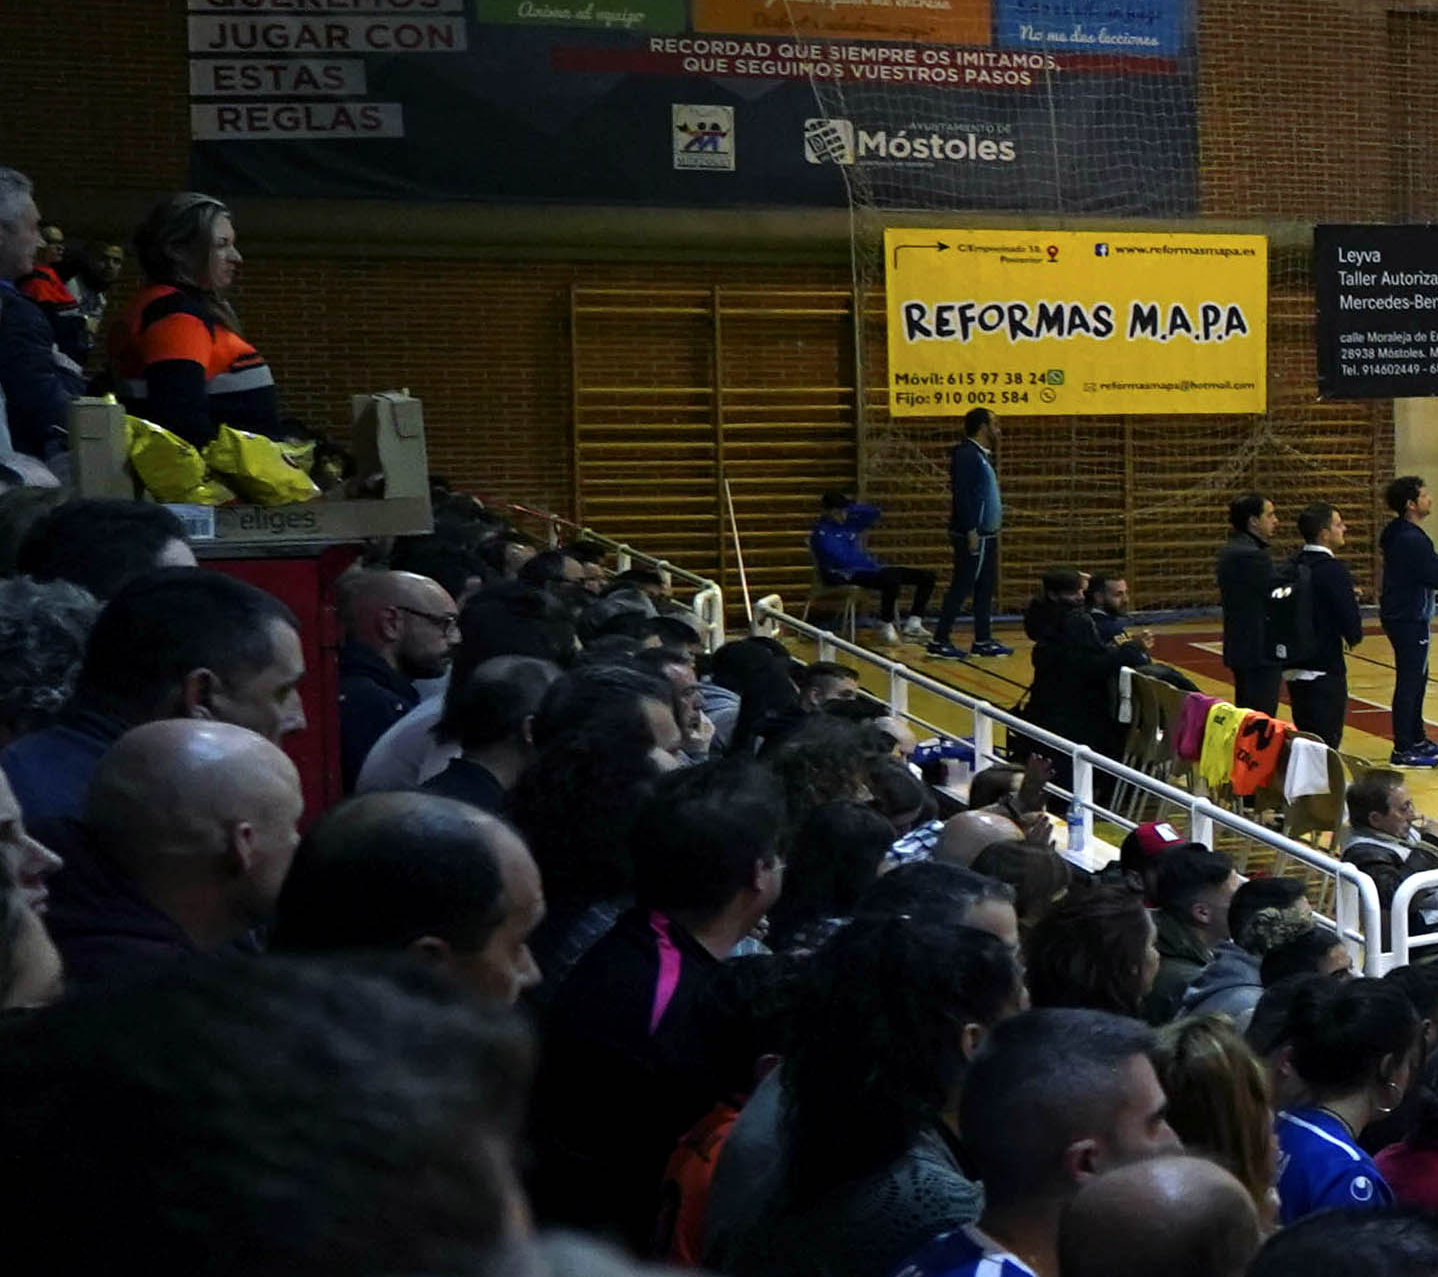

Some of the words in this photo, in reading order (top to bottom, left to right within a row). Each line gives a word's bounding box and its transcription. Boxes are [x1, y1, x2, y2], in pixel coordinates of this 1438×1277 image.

[208, 24, 350, 50] JUGAR
[364, 24, 454, 49] CON
[650, 37, 771, 58] RECORDAD
[778, 42, 822, 60] QUE
[829, 44, 916, 65] SIEMPRE
[925, 50, 951, 66] OS
[956, 51, 1062, 72] IMITAMOS,
[213, 65, 346, 91] ESTAS
[684, 56, 729, 73] QUE
[735, 58, 844, 78] SEGUIMOS
[852, 64, 959, 83] VUESTROS
[965, 68, 1032, 86] PASOS
[216, 106, 384, 132] REGLAS
[857, 128, 1017, 161] Móstoles
[1114, 245, 1256, 258] www.reformasmapa.es
[1338, 247, 1381, 267] Leyva
[1338, 270, 1377, 286] Taller
[903, 301, 1115, 343] REFORMAS
[1128, 301, 1249, 342] M.A.P.A
[1339, 331, 1365, 343] calle
[1367, 331, 1412, 345] Moraleja
[1414, 331, 1427, 342] de
[1341, 347, 1375, 360] 28938
[895, 372, 944, 386] Móvil:
[947, 372, 974, 385] 615
[981, 372, 998, 385] 97
[1004, 372, 1024, 385] 38
[1029, 372, 1046, 385] 24
[1341, 363, 1360, 376] Tel.
[1362, 363, 1420, 375] 914602449
[895, 391, 931, 406] Fijo:
[934, 391, 963, 404] 910
[968, 391, 997, 404] 002
[1002, 391, 1029, 404] 584
